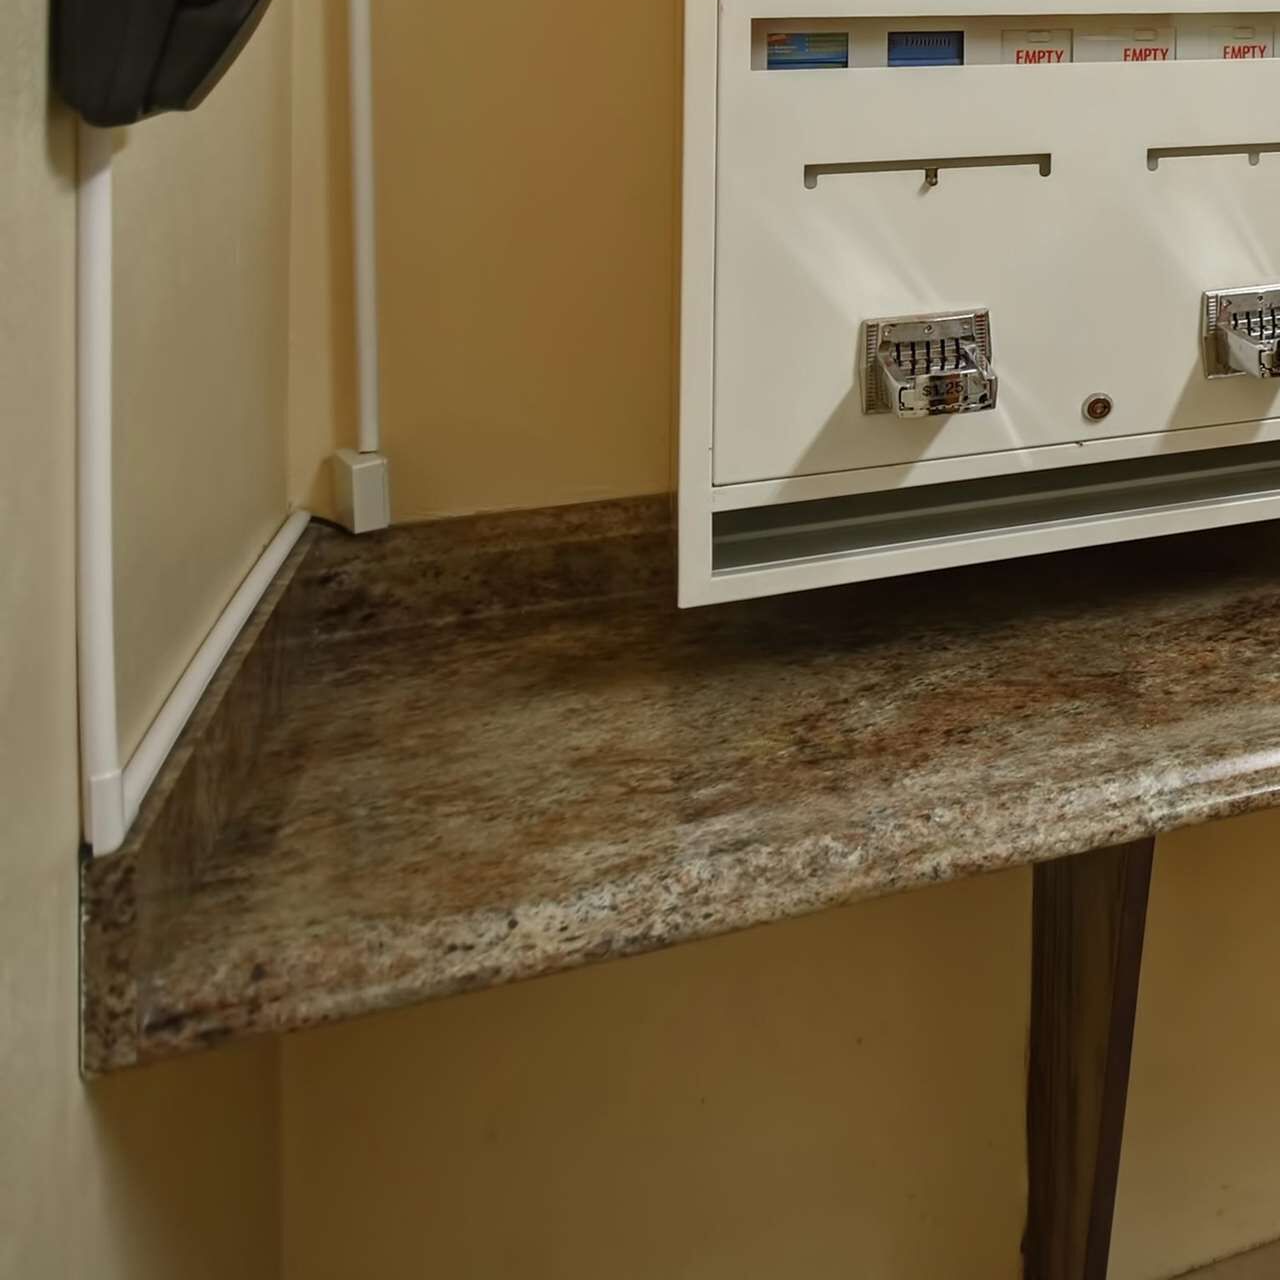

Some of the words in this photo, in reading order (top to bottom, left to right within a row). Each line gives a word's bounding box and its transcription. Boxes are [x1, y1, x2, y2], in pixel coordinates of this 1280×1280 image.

[1016, 50, 1064, 64] EMPTY
[1124, 48, 1169, 61] EMPTY
[1223, 45, 1267, 59] EMPTY
[922, 381, 964, 397] $1.25
